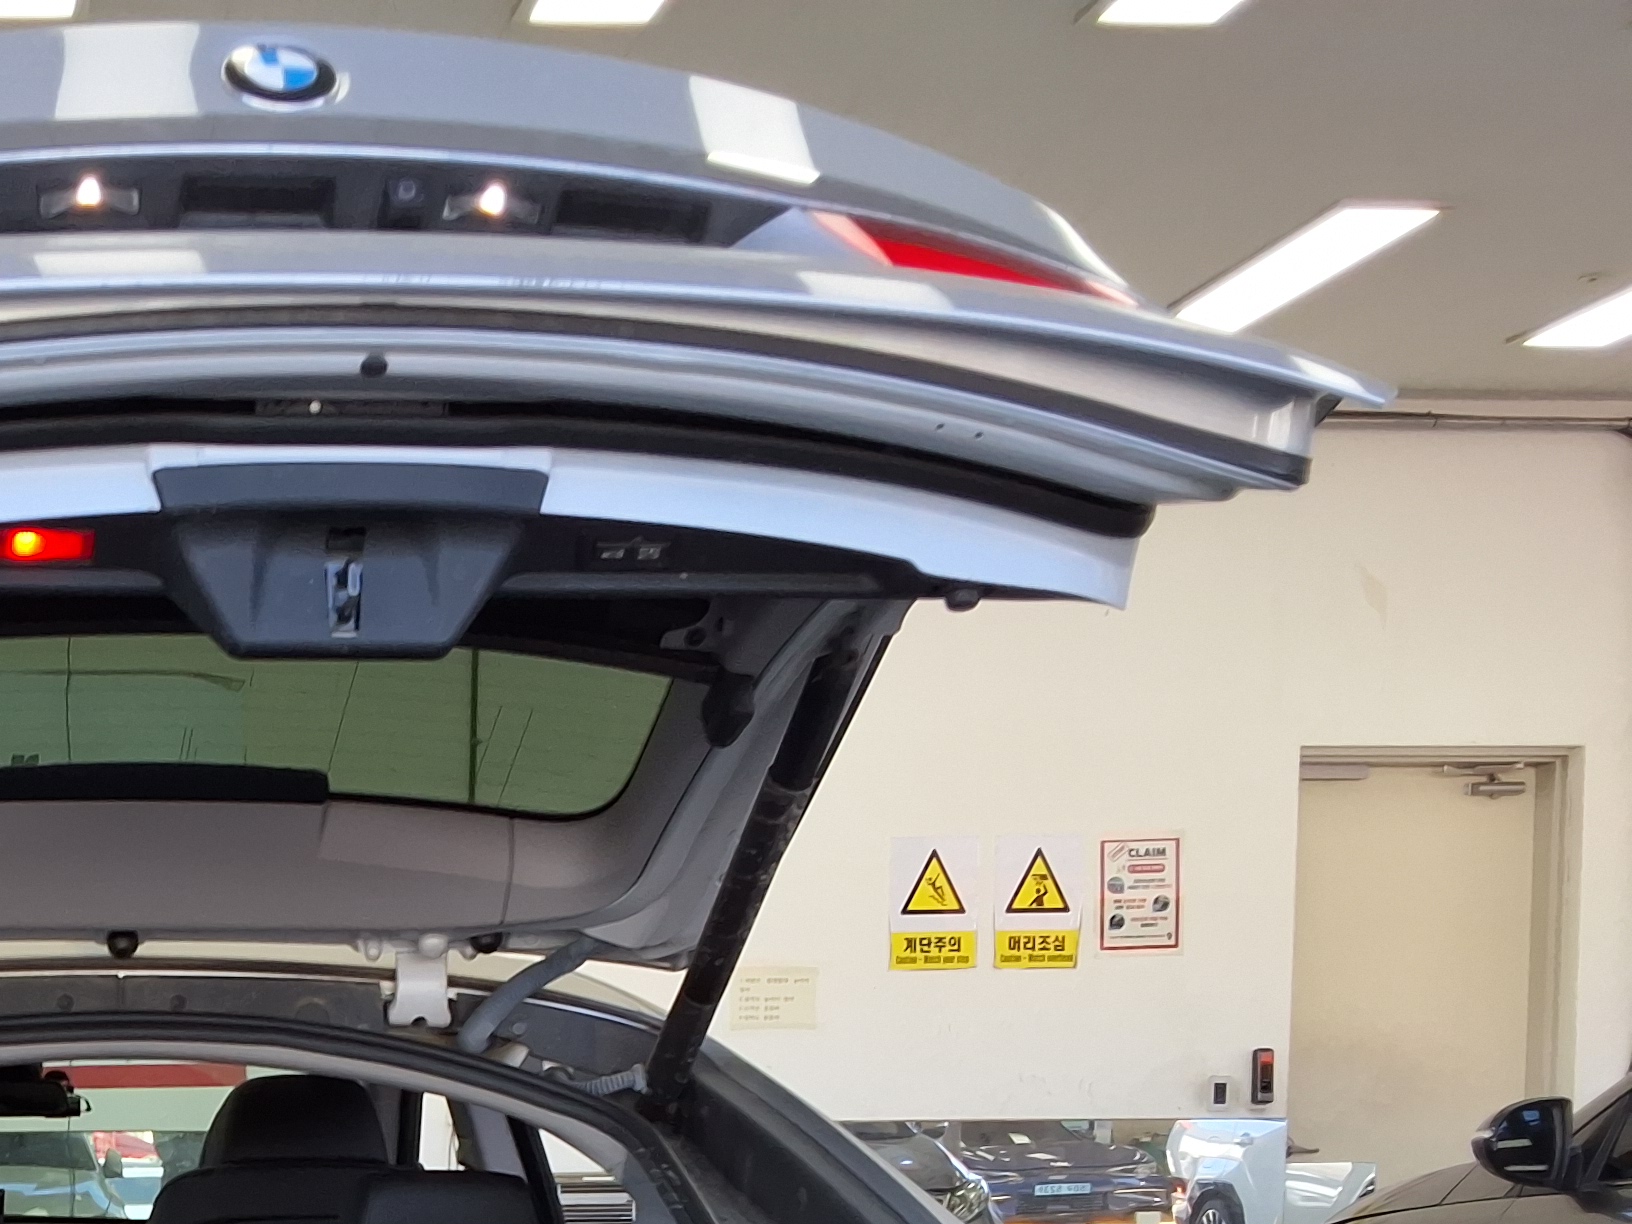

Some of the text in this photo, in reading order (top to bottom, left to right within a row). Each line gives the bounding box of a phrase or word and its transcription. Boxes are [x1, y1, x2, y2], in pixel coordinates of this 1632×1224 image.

[1128, 847, 1167, 858] CLAIM
[903, 936, 962, 953] 계단주의
[1008, 935, 1066, 952] 머리조심
